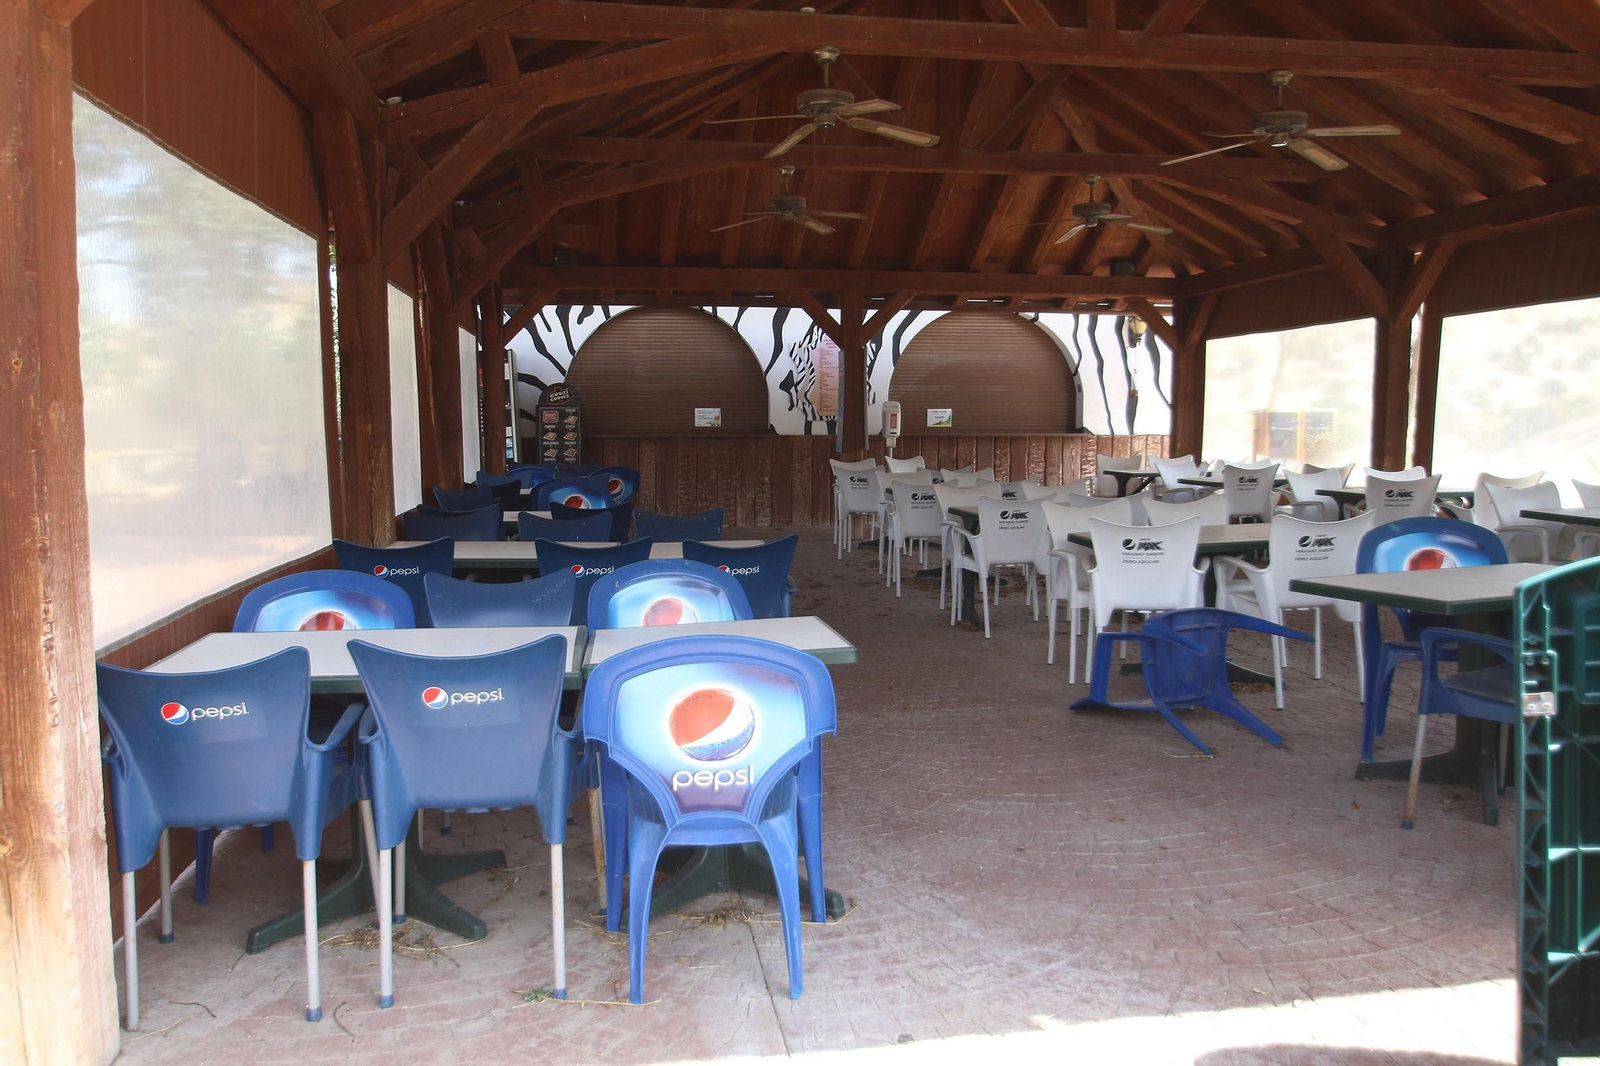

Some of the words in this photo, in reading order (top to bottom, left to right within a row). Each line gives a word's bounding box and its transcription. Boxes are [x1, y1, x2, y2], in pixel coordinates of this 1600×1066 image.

[1010, 511, 1030, 520] MAX
[1137, 540, 1165, 551] MAX
[1311, 536, 1337, 548] MAX
[390, 566, 420, 576] pepsi
[586, 566, 616, 576] pepsi
[731, 565, 760, 576] pepsi
[451, 687, 504, 706] pepsi
[191, 702, 248, 721] pepsi
[672, 764, 755, 792] pepsi
